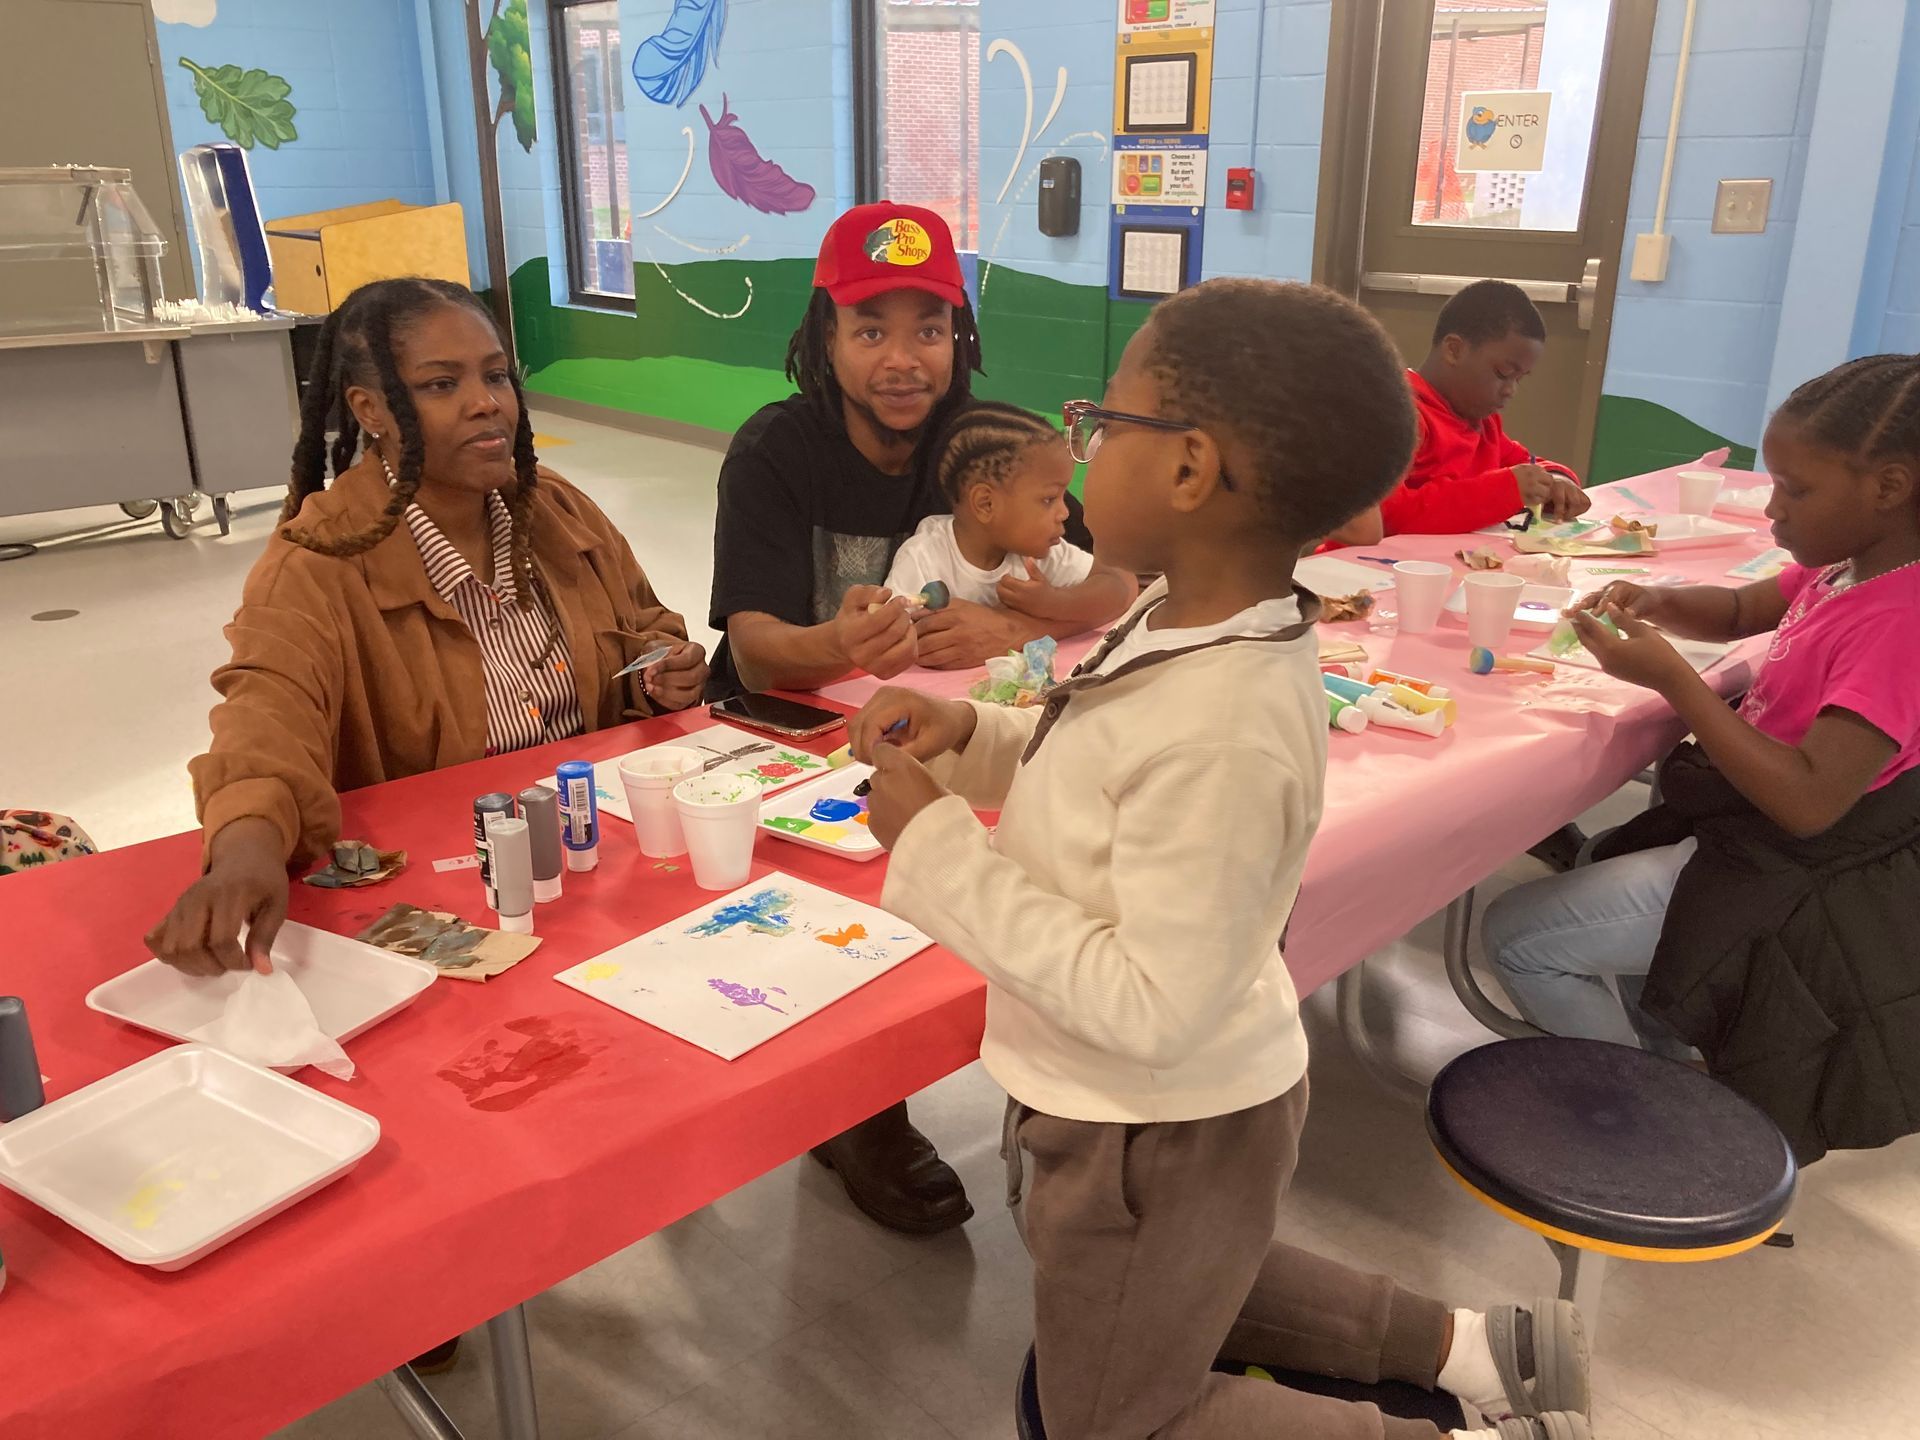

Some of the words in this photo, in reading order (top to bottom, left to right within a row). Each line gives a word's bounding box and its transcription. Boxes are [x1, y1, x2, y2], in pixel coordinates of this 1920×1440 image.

[1497, 114, 1539, 127] ENTER
[895, 220, 920, 234] Bass
[896, 233, 916, 245] Pro
[896, 245, 928, 259] Shops
